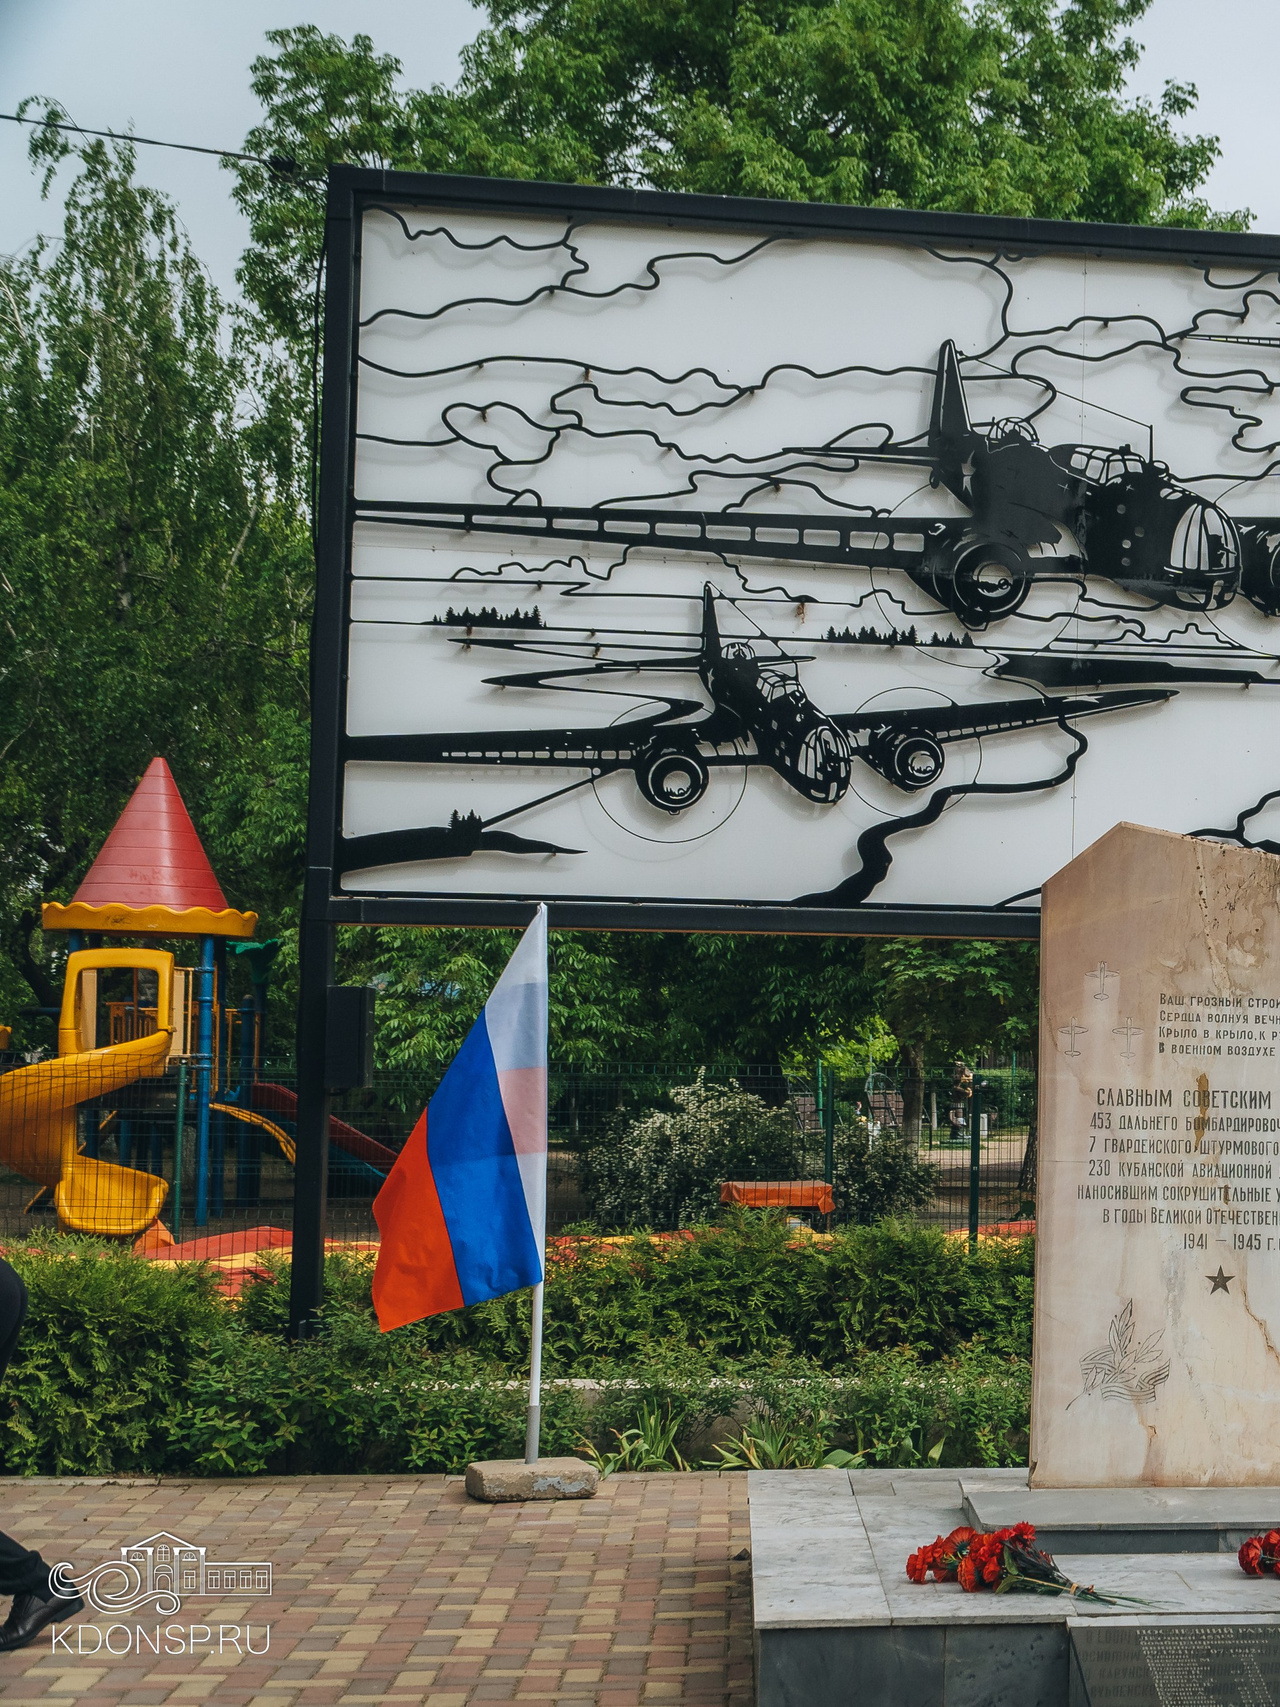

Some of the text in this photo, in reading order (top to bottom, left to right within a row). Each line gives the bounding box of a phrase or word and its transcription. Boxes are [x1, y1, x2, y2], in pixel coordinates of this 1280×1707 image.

[1159, 993, 1184, 1006] ВАШ
[1190, 995, 1242, 1008] ГРОЗНЫЙ
[1159, 1010, 1201, 1023] СЕРДЦА
[1207, 1013, 1249, 1024] ВОЛНУЯ
[1159, 1026, 1198, 1039] КРЫЛО
[1203, 1029, 1210, 1039] В
[1158, 1042, 1165, 1054] В
[1171, 1044, 1222, 1056] ВОЕННОМ
[1227, 1045, 1276, 1057] ВОЗДУХЕ
[1097, 1088, 1172, 1107] СЛАВНЫМ
[1183, 1089, 1271, 1110] СОВЕТСКИМ
[1090, 1112, 1112, 1129] 453
[1118, 1115, 1178, 1131] ДАЛЬНЕГО
[1089, 1136, 1097, 1153] 7
[1104, 1136, 1192, 1154] ГВАРДЕЙСКОГО
[1199, 1139, 1279, 1156] ШТУРМОВОГО
[1088, 1159, 1111, 1177] 230
[1118, 1160, 1184, 1178] КУБАНСКОЙ
[1192, 1161, 1272, 1179] АВИАЦИОННОЙ
[1077, 1184, 1158, 1201] НАНОСИВШИМ
[1162, 1185, 1272, 1203] СОКРУШИТЕЛЬНЫЕ
[1102, 1208, 1110, 1223] В
[1114, 1208, 1147, 1224] ГОДЫ
[1150, 1206, 1202, 1225] ВЕЛИКОЙ
[1183, 1233, 1208, 1250] 1941
[1233, 1233, 1262, 1250] 1945
